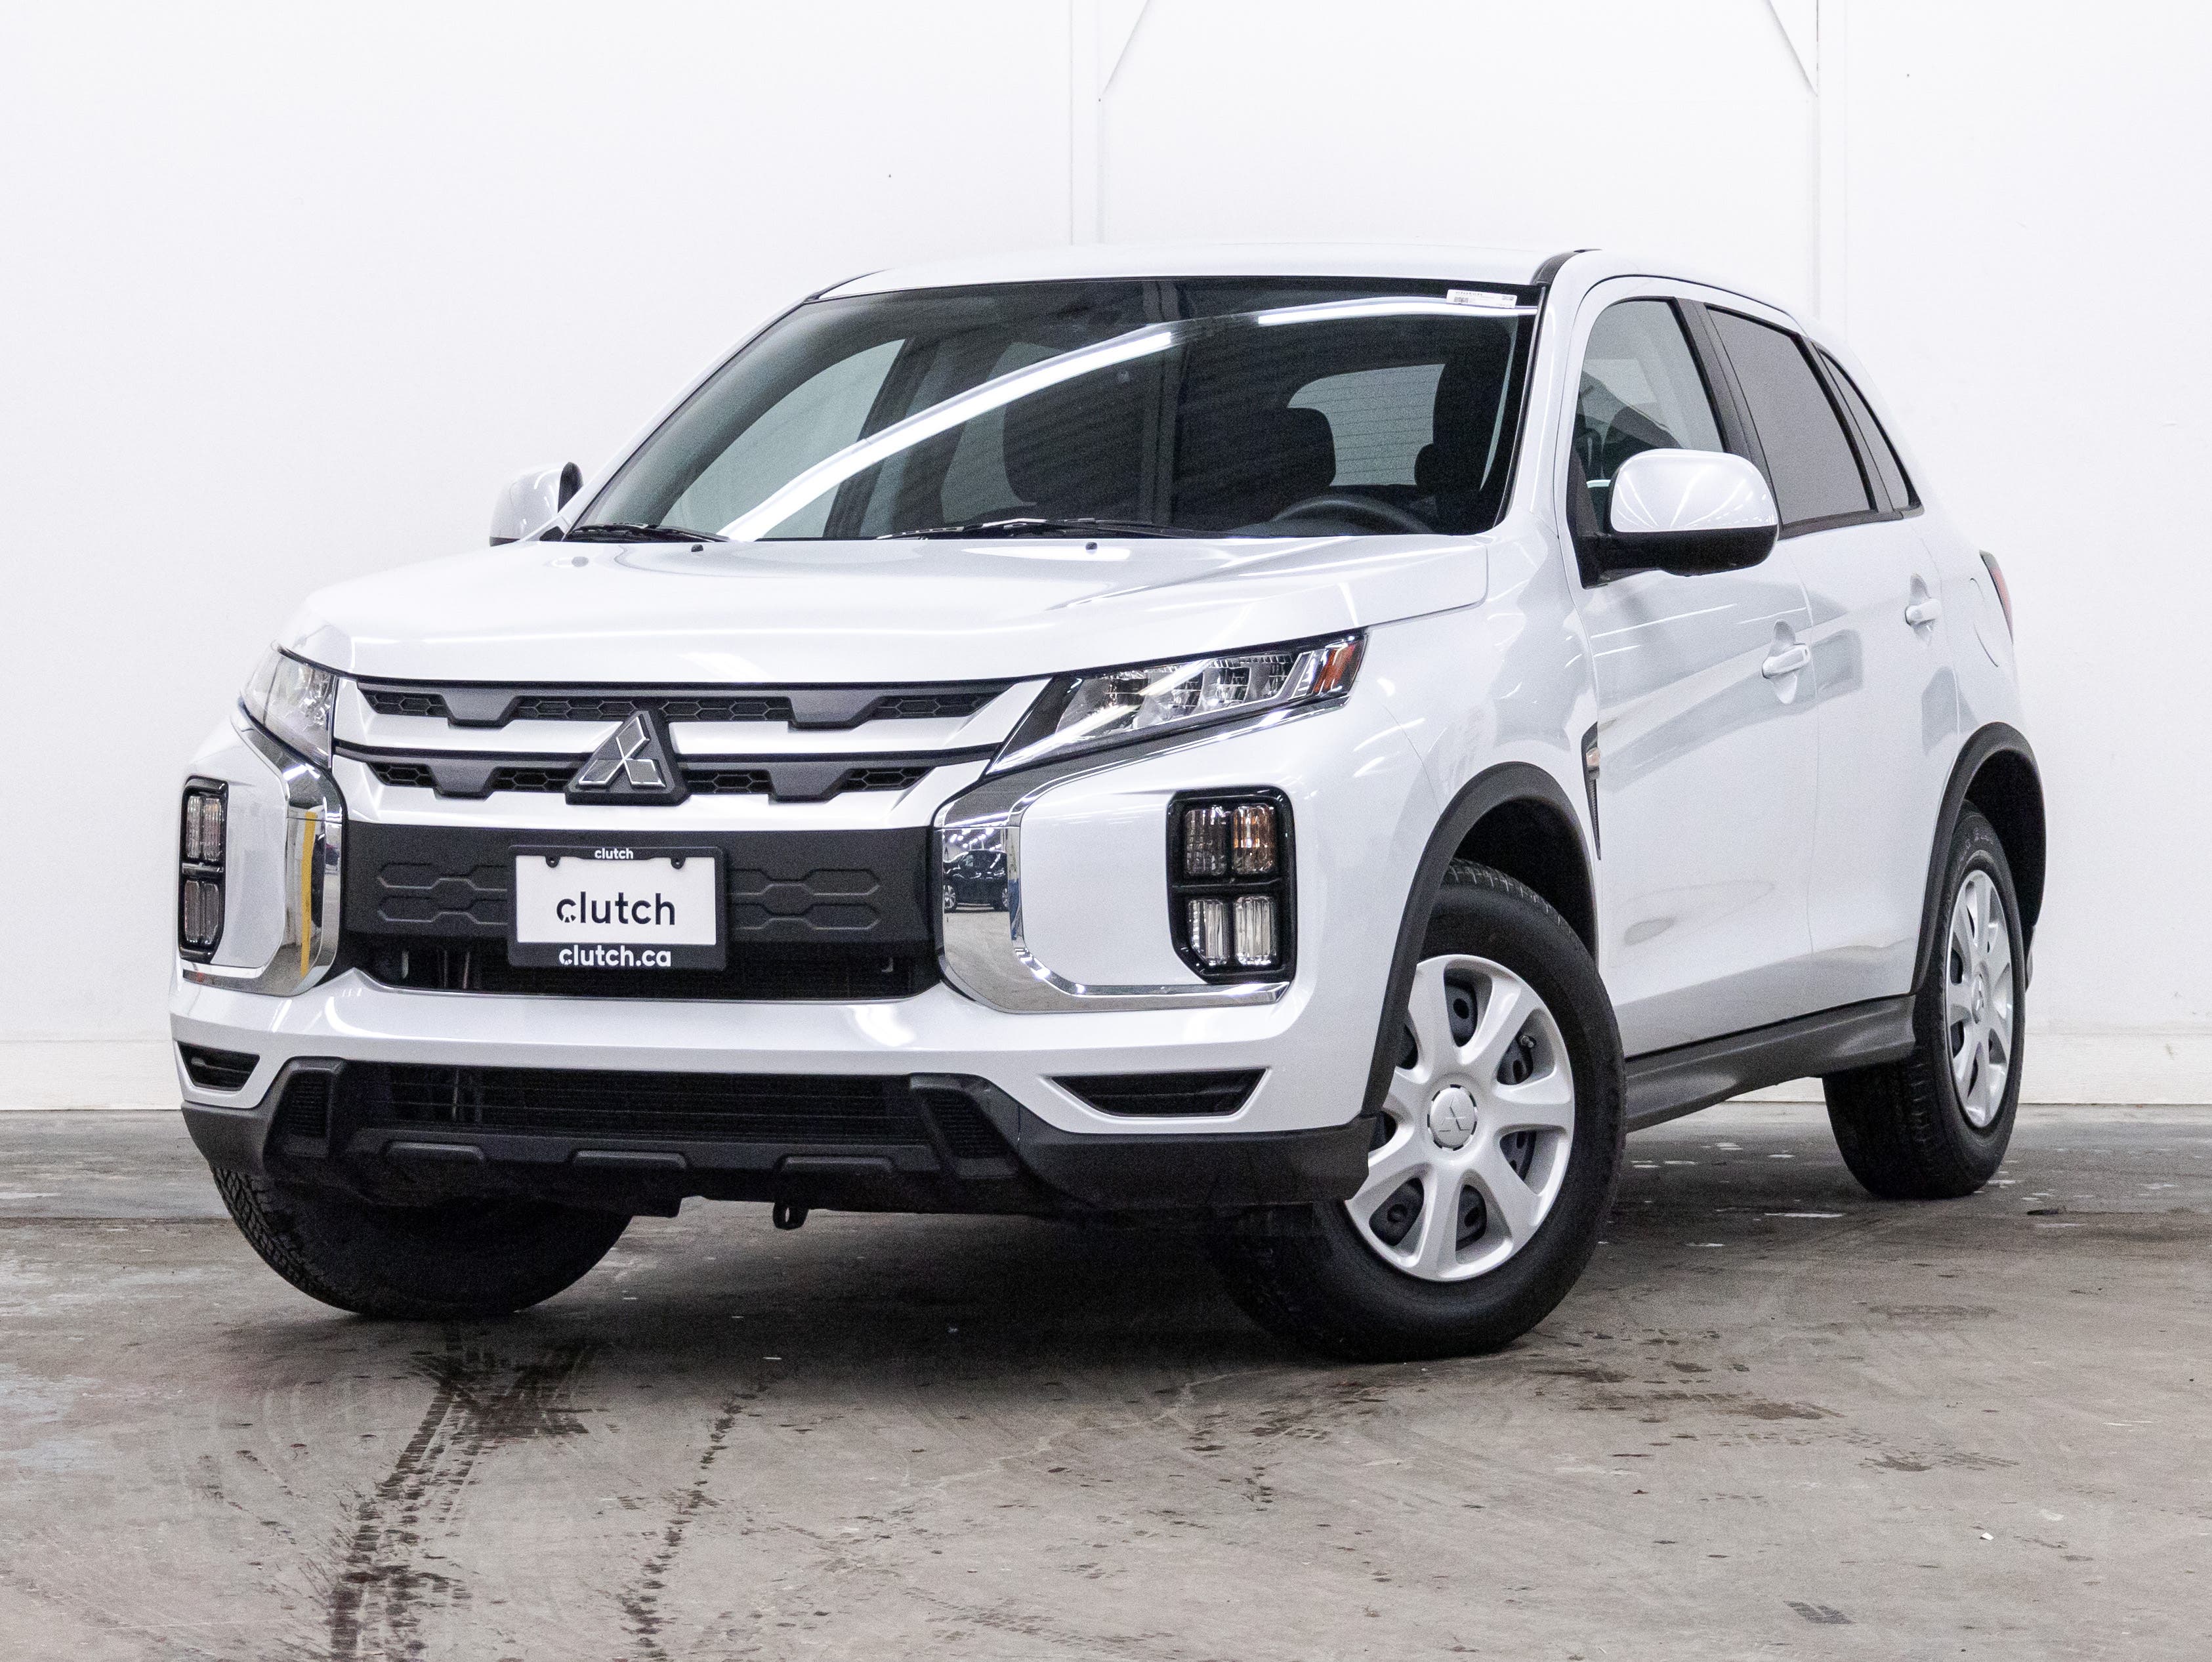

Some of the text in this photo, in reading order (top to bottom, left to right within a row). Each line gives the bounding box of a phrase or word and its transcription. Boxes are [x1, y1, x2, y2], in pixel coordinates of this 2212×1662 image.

[595, 848, 634, 860] clutch
[556, 891, 675, 925] clutch
[559, 944, 671, 967] clutch.ca
